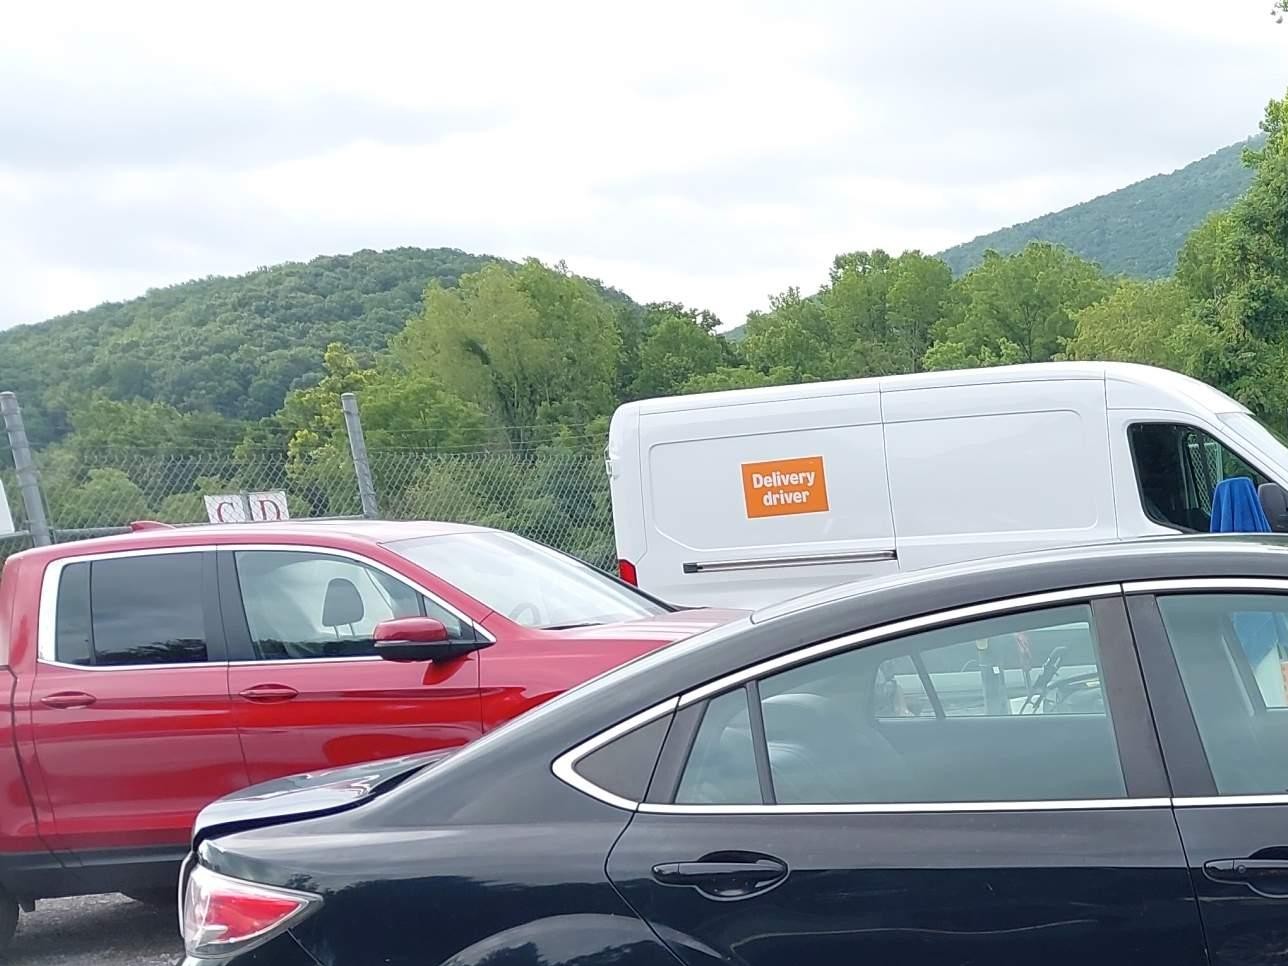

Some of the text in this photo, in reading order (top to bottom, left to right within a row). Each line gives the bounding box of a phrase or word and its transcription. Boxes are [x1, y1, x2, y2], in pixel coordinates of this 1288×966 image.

[752, 471, 816, 488] Delivery
[763, 490, 810, 506] driver
[258, 499, 282, 520] D
